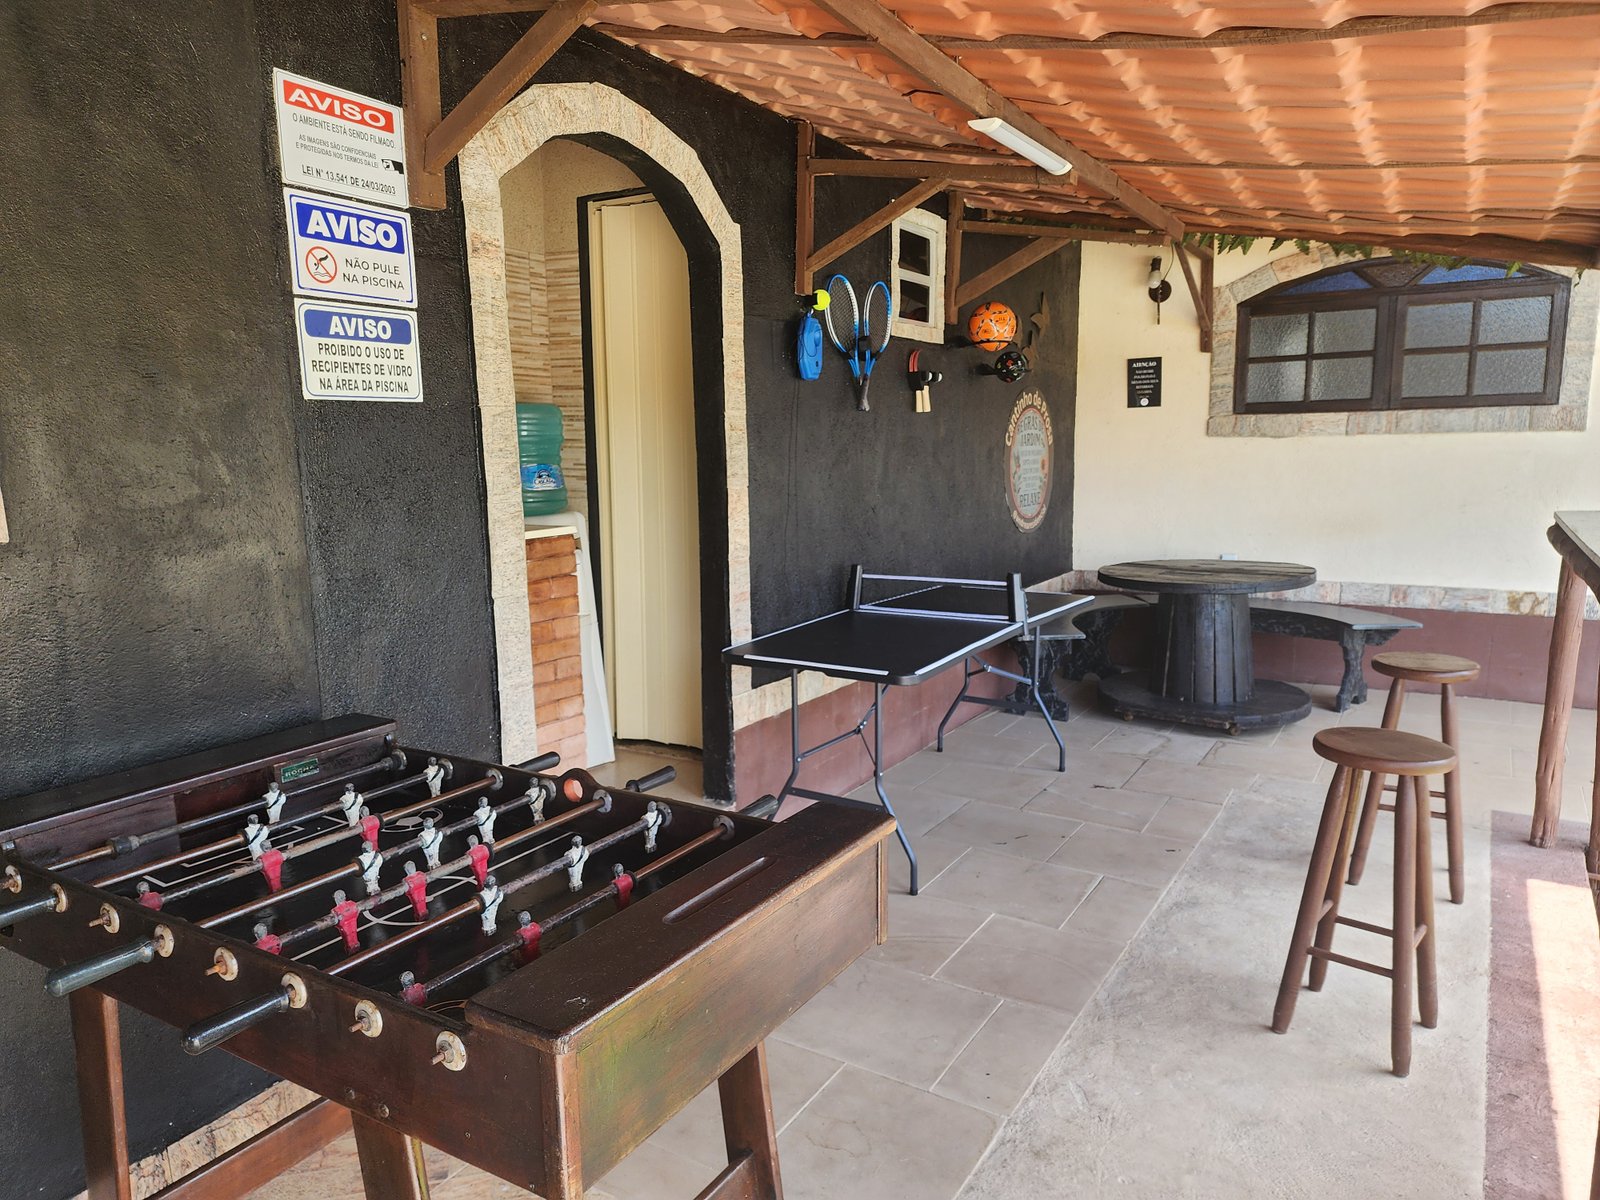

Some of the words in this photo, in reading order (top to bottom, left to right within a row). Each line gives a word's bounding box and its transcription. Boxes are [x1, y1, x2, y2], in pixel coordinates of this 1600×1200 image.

[289, 88, 386, 127] AVISO
[293, 113, 298, 122] O
[299, 114, 331, 131] AMBIENTE
[332, 124, 347, 136] ESTÁ
[348, 130, 369, 142] SENDO
[370, 134, 396, 149] FILMADO.
[299, 134, 306, 142] AS
[307, 136, 330, 148] IMAGENS
[330, 141, 341, 150] SÃO
[341, 144, 377, 160] CONFIDENCIAIS
[300, 143, 332, 157] PROTEGIDAS
[333, 151, 343, 160] NOS
[344, 153, 363, 165] TERMOS
[364, 159, 371, 167] DA
[371, 161, 379, 169] LEI
[302, 164, 314, 176] LEI
[326, 170, 349, 184] 13.541
[350, 175, 360, 187] DE
[361, 178, 396, 195] 24/03/2003
[306, 209, 398, 249] AVISO
[345, 257, 370, 270] NÃO
[373, 262, 400, 275] PULE
[342, 273, 359, 284] NA
[362, 276, 405, 290] PISCINA
[329, 315, 392, 340] AVISO
[318, 343, 362, 358] PROIBIDO
[365, 346, 371, 358] O
[374, 347, 391, 360] USO
[394, 349, 405, 360] DE
[312, 360, 371, 375] RECIPIENTES
[374, 363, 385, 376] DE
[387, 364, 413, 377] VIDRO
[320, 377, 333, 391] NA
[335, 375, 360, 391] ÁREA
[362, 380, 373, 391] DA
[376, 380, 409, 393] PISCINA
[1005, 391, 1033, 446] Cantinho
[1033, 390, 1042, 409] de
